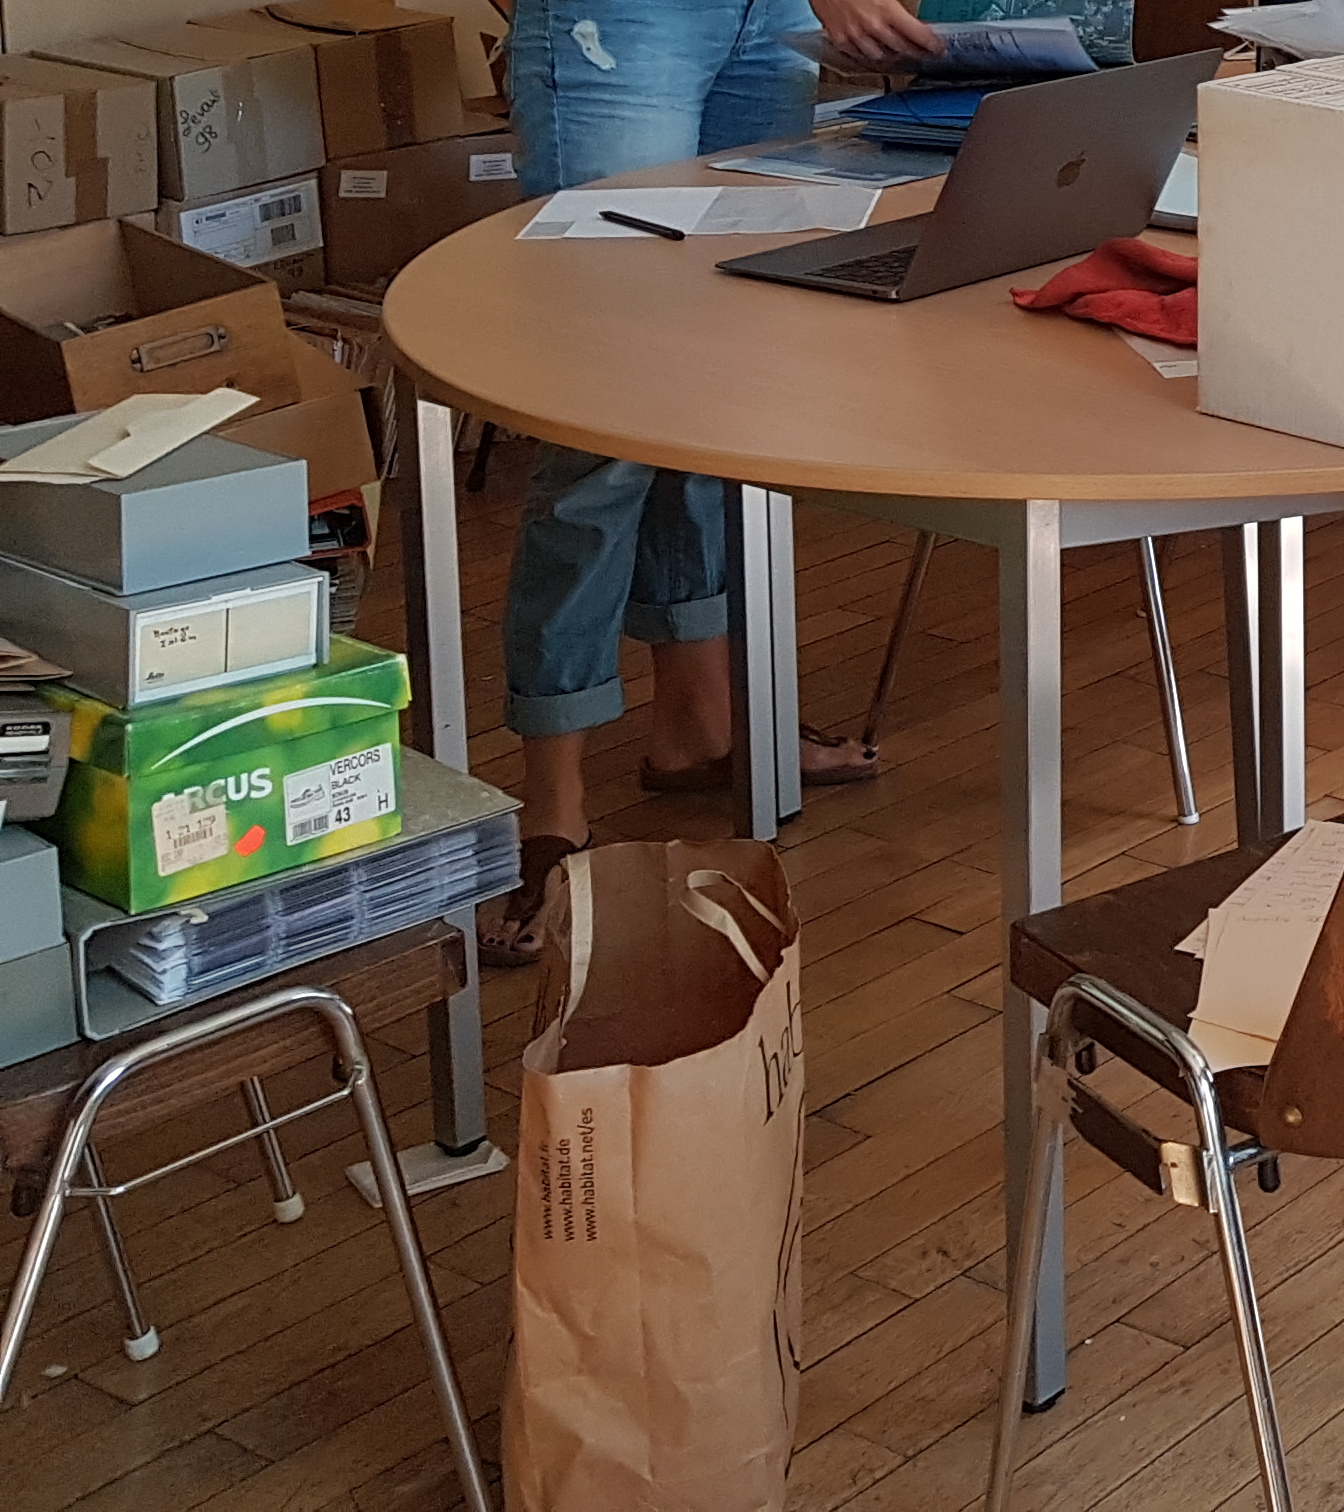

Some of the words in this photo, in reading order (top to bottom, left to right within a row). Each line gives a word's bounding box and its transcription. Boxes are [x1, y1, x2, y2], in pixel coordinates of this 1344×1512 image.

[196, 124, 219, 154] 98
[330, 748, 381, 776] VERCORS
[161, 767, 273, 814] RCUS
[331, 773, 361, 791] BLACK
[335, 806, 351, 825] 43
[377, 792, 389, 811] H
[576, 1106, 597, 1242] www.habitat.net/es
[556, 1138, 575, 1242] www.habitat.de
